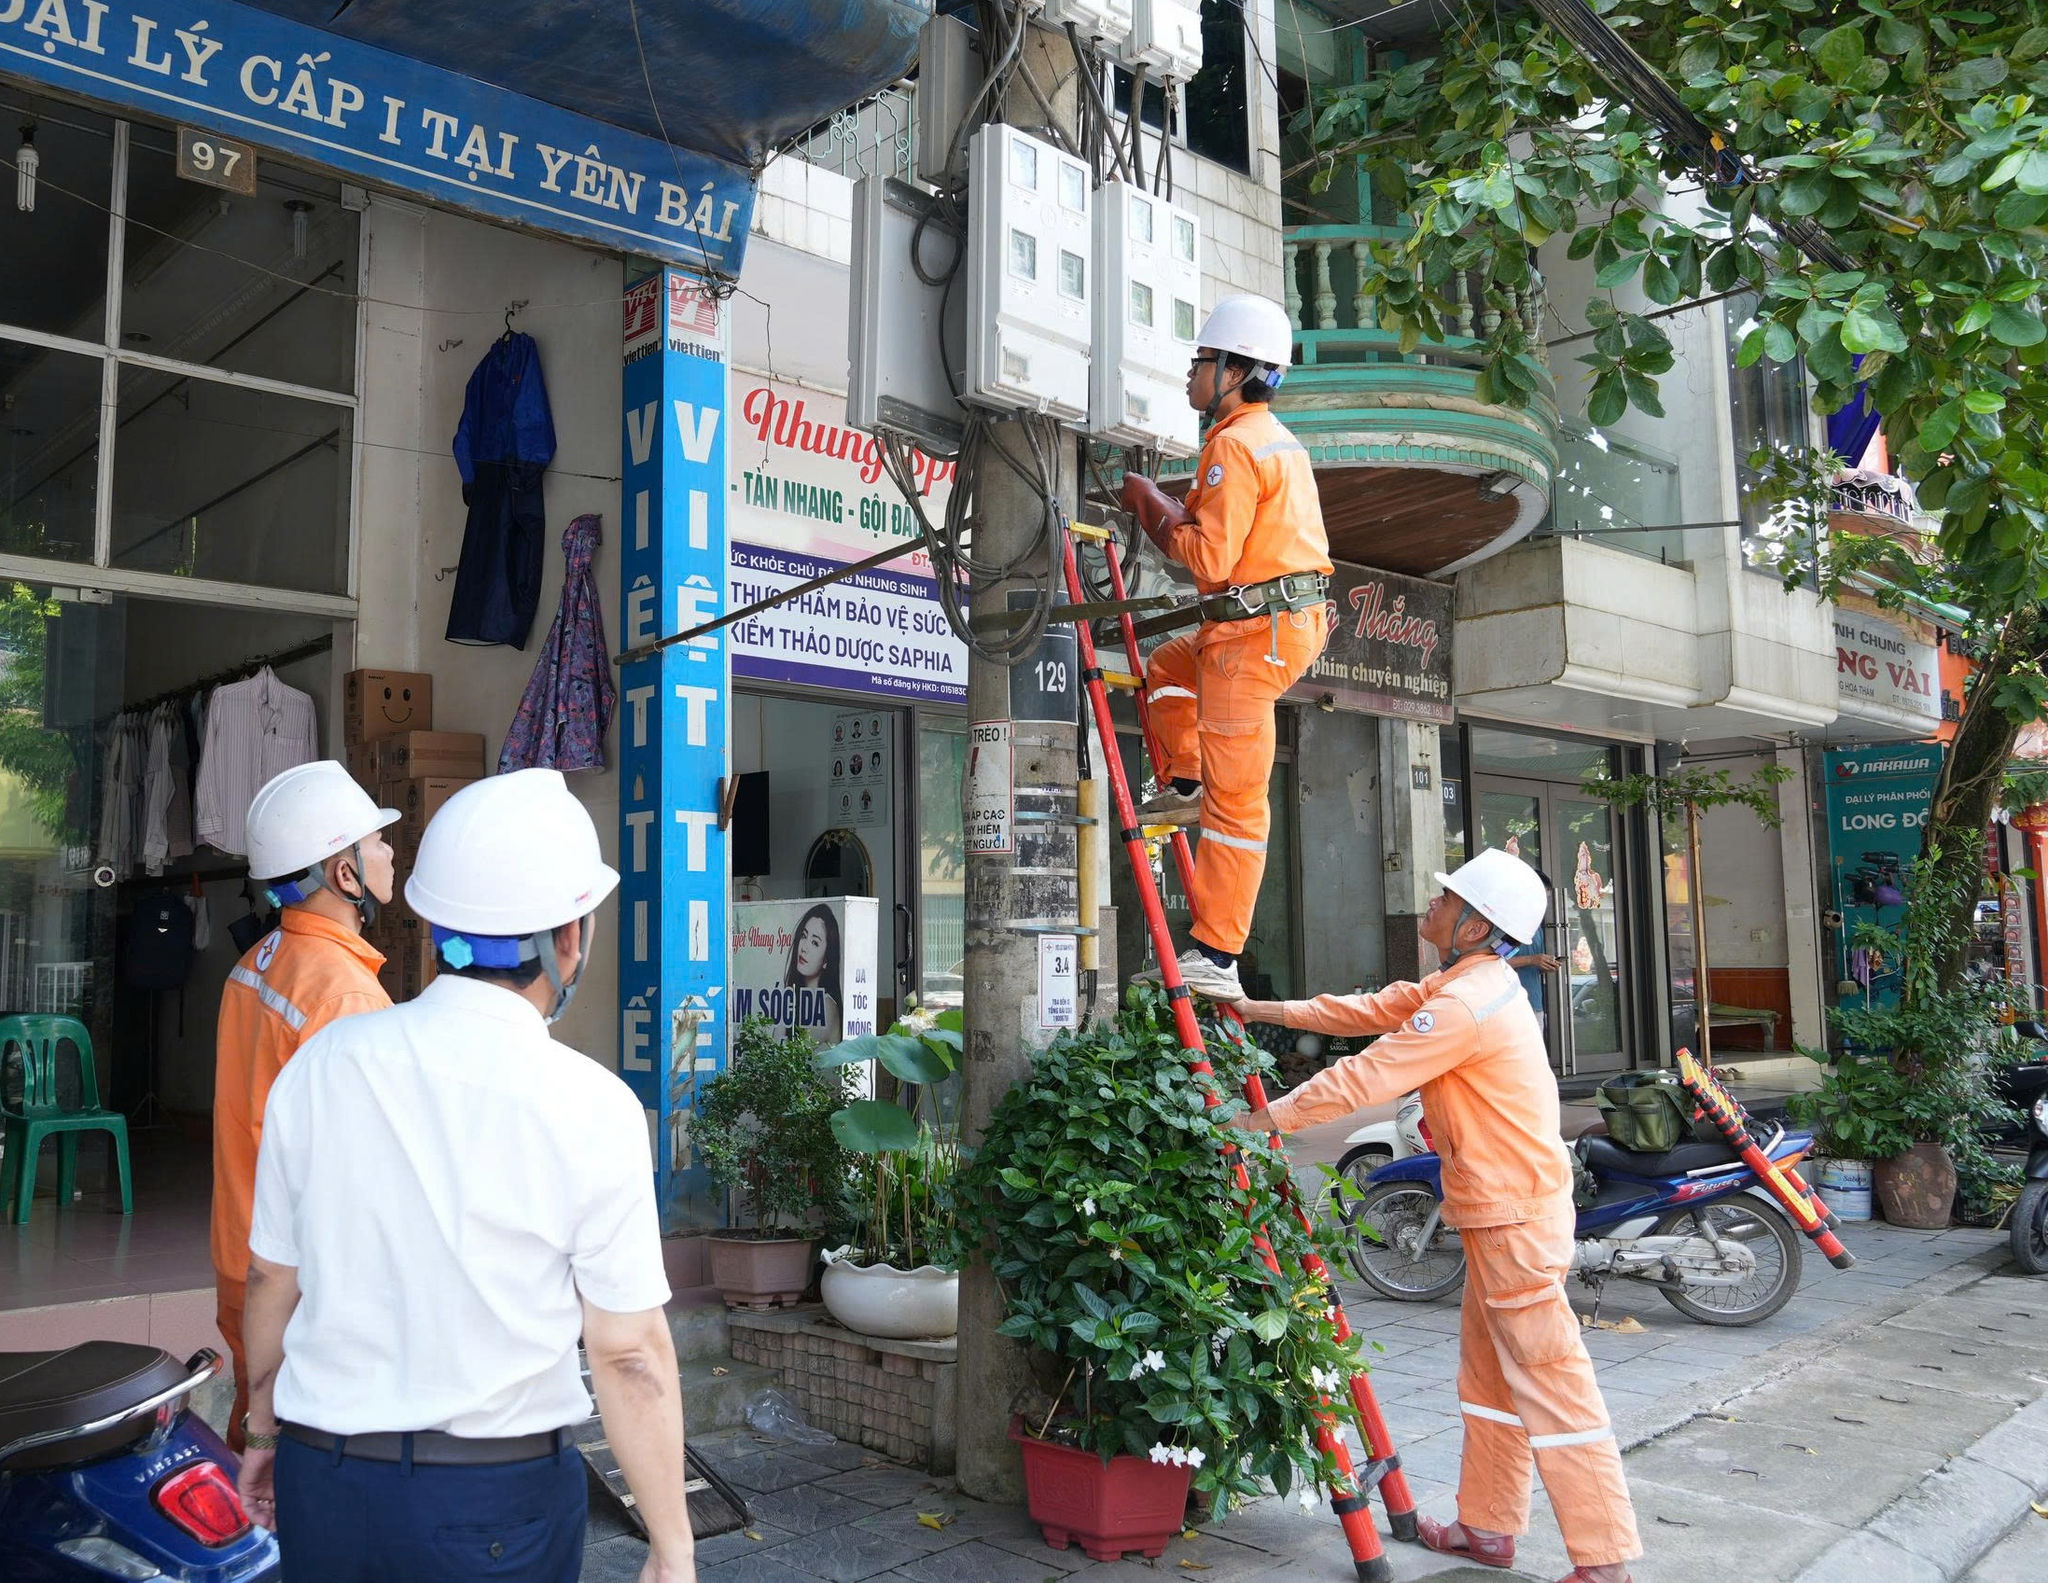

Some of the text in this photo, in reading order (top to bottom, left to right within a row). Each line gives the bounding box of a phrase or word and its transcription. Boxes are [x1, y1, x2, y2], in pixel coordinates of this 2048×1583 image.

[128, 15, 223, 87] LÝ
[240, 51, 365, 129] CẤP
[379, 95, 405, 145] I
[422, 108, 519, 182] TẠI
[536, 143, 646, 215] YÊN
[654, 181, 739, 243] BÁI
[192, 141, 241, 177] 97
[624, 340, 658, 366] viettien
[669, 339, 720, 362] viettien
[743, 388, 886, 484] Nhung
[743, 466, 778, 510] TÀN
[784, 480, 843, 523] NHANG
[860, 493, 887, 538] GỘI
[731, 549, 747, 565] ỨC
[750, 555, 786, 573] KHỎE
[789, 562, 815, 577] CHỦ
[855, 574, 897, 592] NHUNG
[900, 582, 927, 597] SINH
[788, 586, 841, 619] PHẨM
[846, 597, 882, 626] BẢO
[886, 605, 909, 636] VỆ
[913, 609, 947, 636] SỨC
[1348, 580, 1438, 669] Thắng
[779, 625, 831, 656] THẢO
[836, 637, 884, 667] DƯỢC
[889, 644, 953, 673] SAPHIA
[1860, 631, 1905, 655] CHUNG
[1034, 660, 1067, 692] 129
[1311, 655, 1448, 698] phim chuyên nghiệp
[1836, 647, 1931, 696] NG VẢI
[973, 725, 1000, 743] TRÈO
[1414, 771, 1428, 784] 101
[1443, 786, 1454, 799] 03
[1845, 787, 1931, 805] ĐẠI LÝ PHÂN PHỐI
[1842, 813, 1896, 831] LONG
[748, 926, 774, 955] Nhung
[777, 926, 792, 954] Spa
[856, 968, 866, 983] DA
[1055, 956, 1070, 973] 3.4
[759, 982, 795, 1026] SÓC
[801, 990, 826, 1027] DA
[852, 992, 868, 1009] TÓC
[848, 1018, 872, 1036] MÓNG
